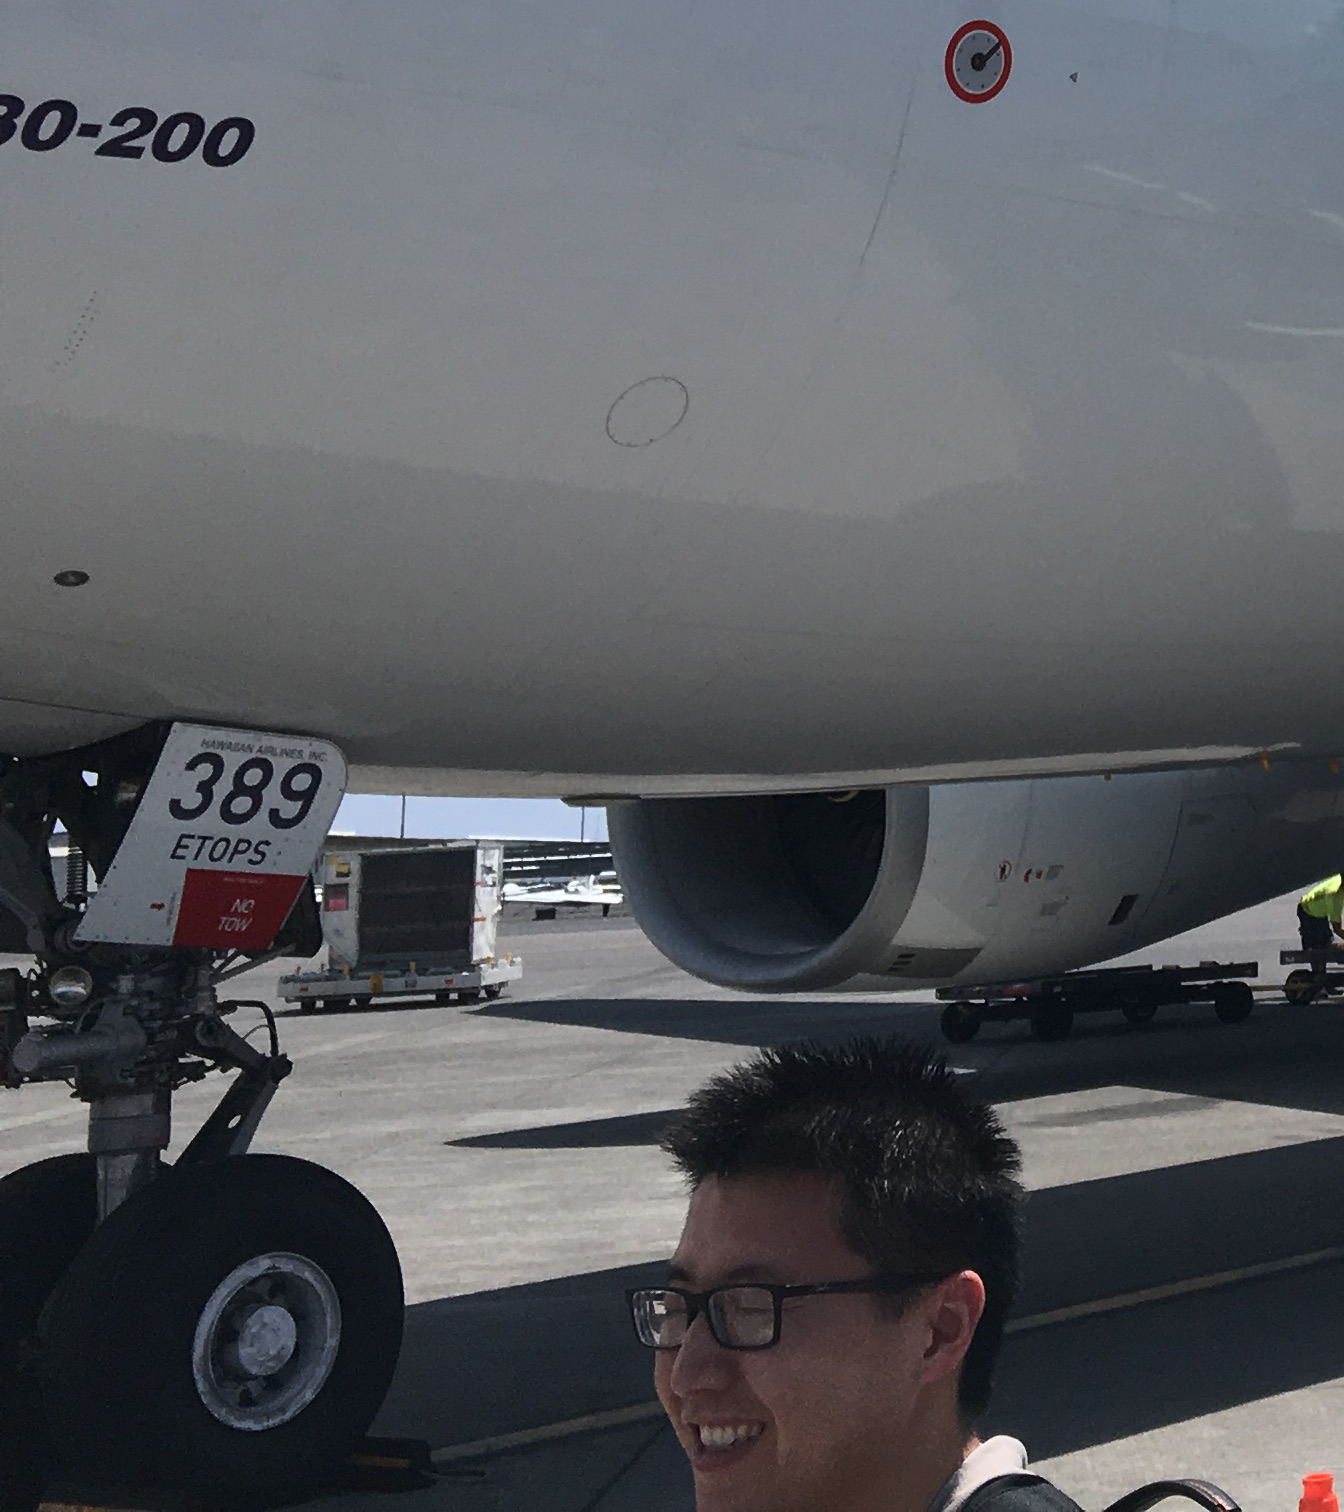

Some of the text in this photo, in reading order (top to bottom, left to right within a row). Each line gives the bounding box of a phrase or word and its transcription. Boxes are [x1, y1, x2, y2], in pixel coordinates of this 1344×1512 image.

[201, 738, 254, 753] HAWAIIAN
[168, 751, 322, 830] 389
[169, 833, 272, 866] ETOPS
[230, 898, 255, 914] NO
[218, 916, 252, 932] TOW
